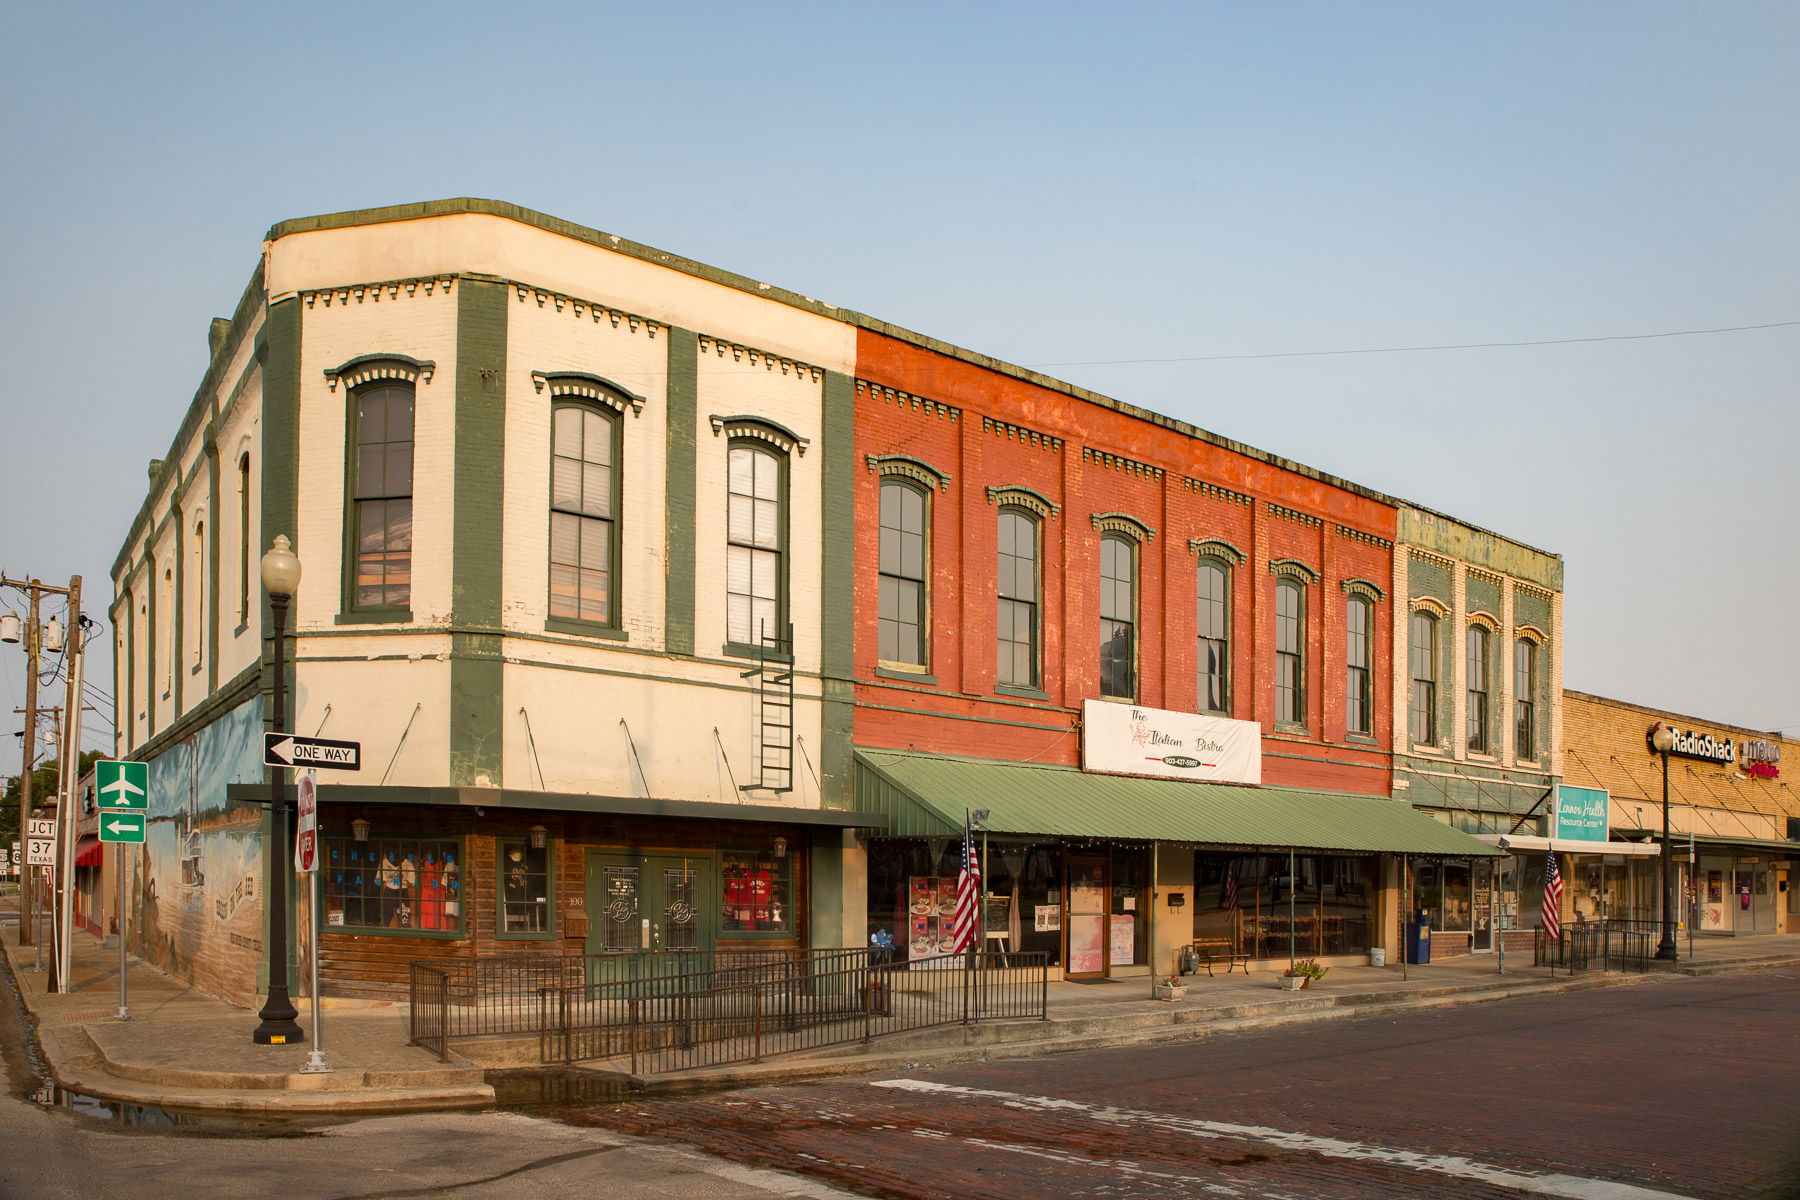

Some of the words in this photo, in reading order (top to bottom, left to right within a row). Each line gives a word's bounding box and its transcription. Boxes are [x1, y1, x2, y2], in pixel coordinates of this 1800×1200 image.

[1130, 709, 1148, 722] The
[1148, 730, 1183, 748] Italian
[1196, 738, 1224, 752] Bistro
[1672, 727, 1737, 761] RadioShack
[294, 746, 320, 759] ONE
[324, 748, 351, 761] WAY
[1583, 800, 1605, 817] Health
[30, 822, 54, 834] JCT
[1560, 817, 1582, 827] Resource
[1584, 819, 1599, 828] Center
[32, 842, 51, 854] 37
